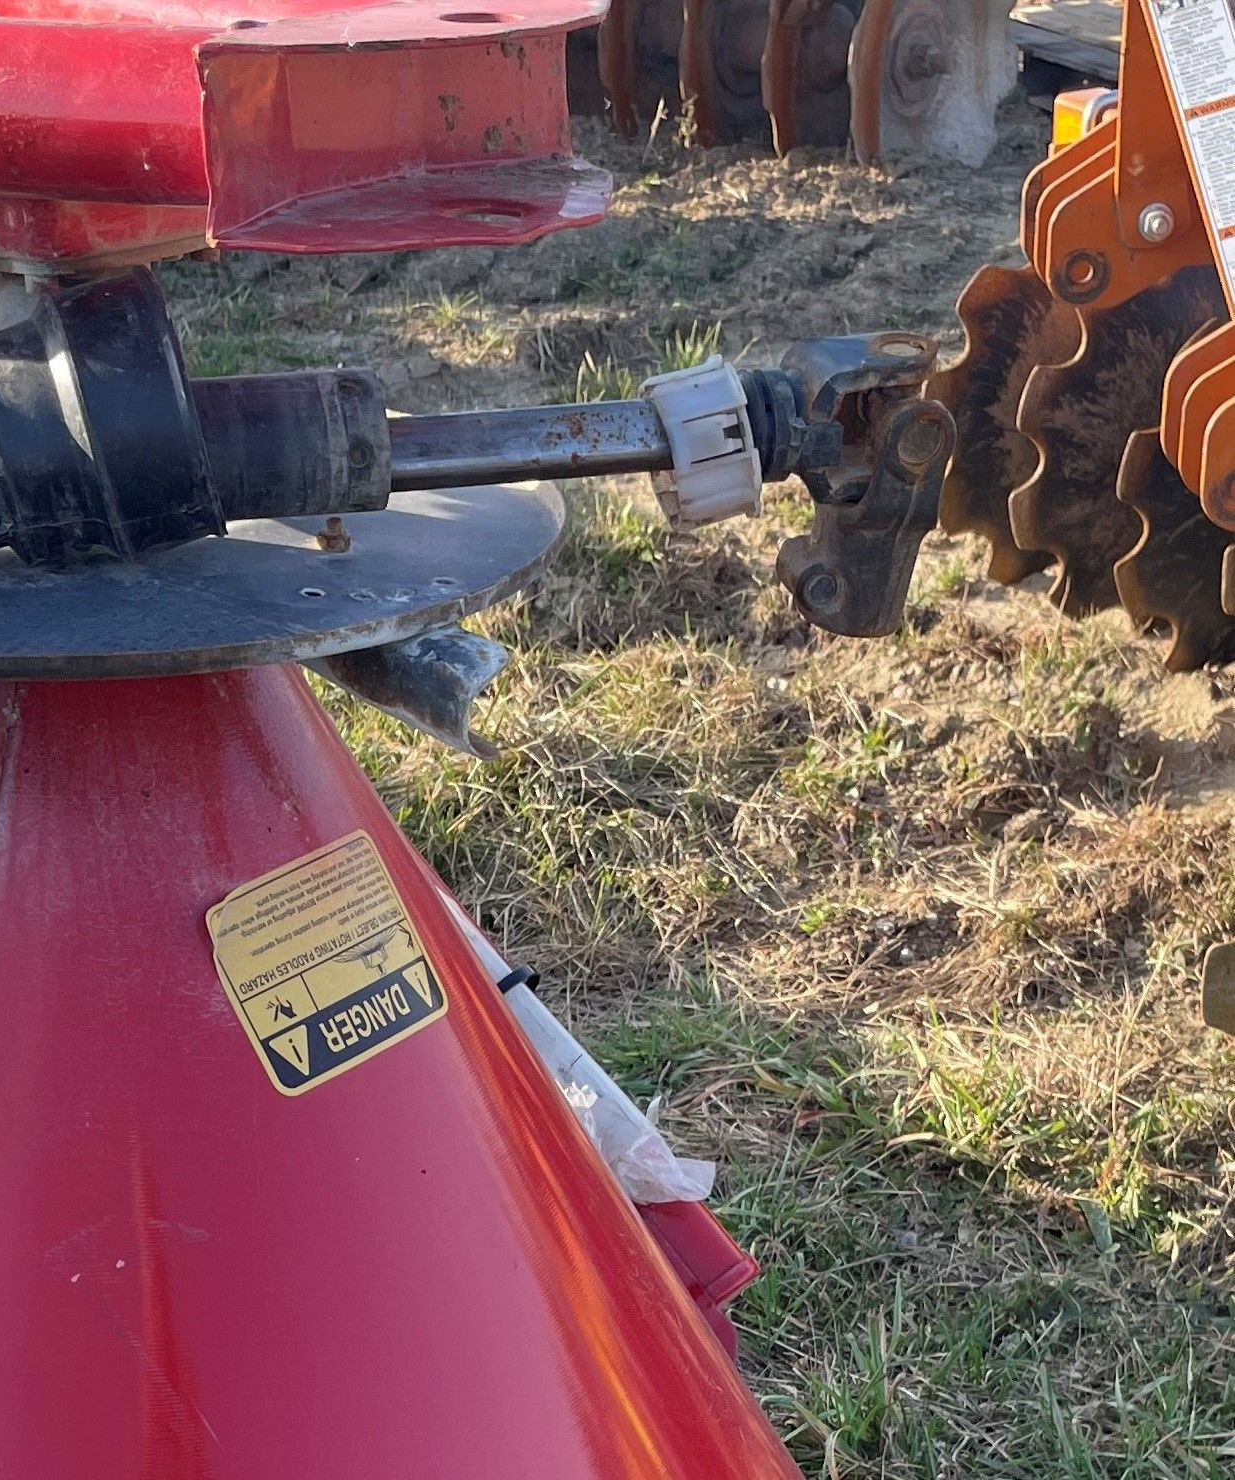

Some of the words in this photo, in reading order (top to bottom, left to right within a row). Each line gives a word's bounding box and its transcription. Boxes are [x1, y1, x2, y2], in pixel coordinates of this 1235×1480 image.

[354, 917, 380, 938] OBJECT
[313, 932, 352, 958] ROTATING
[275, 951, 315, 977] PADDLES
[238, 969, 277, 995] HAZARD
[319, 983, 411, 1052] DANGER
